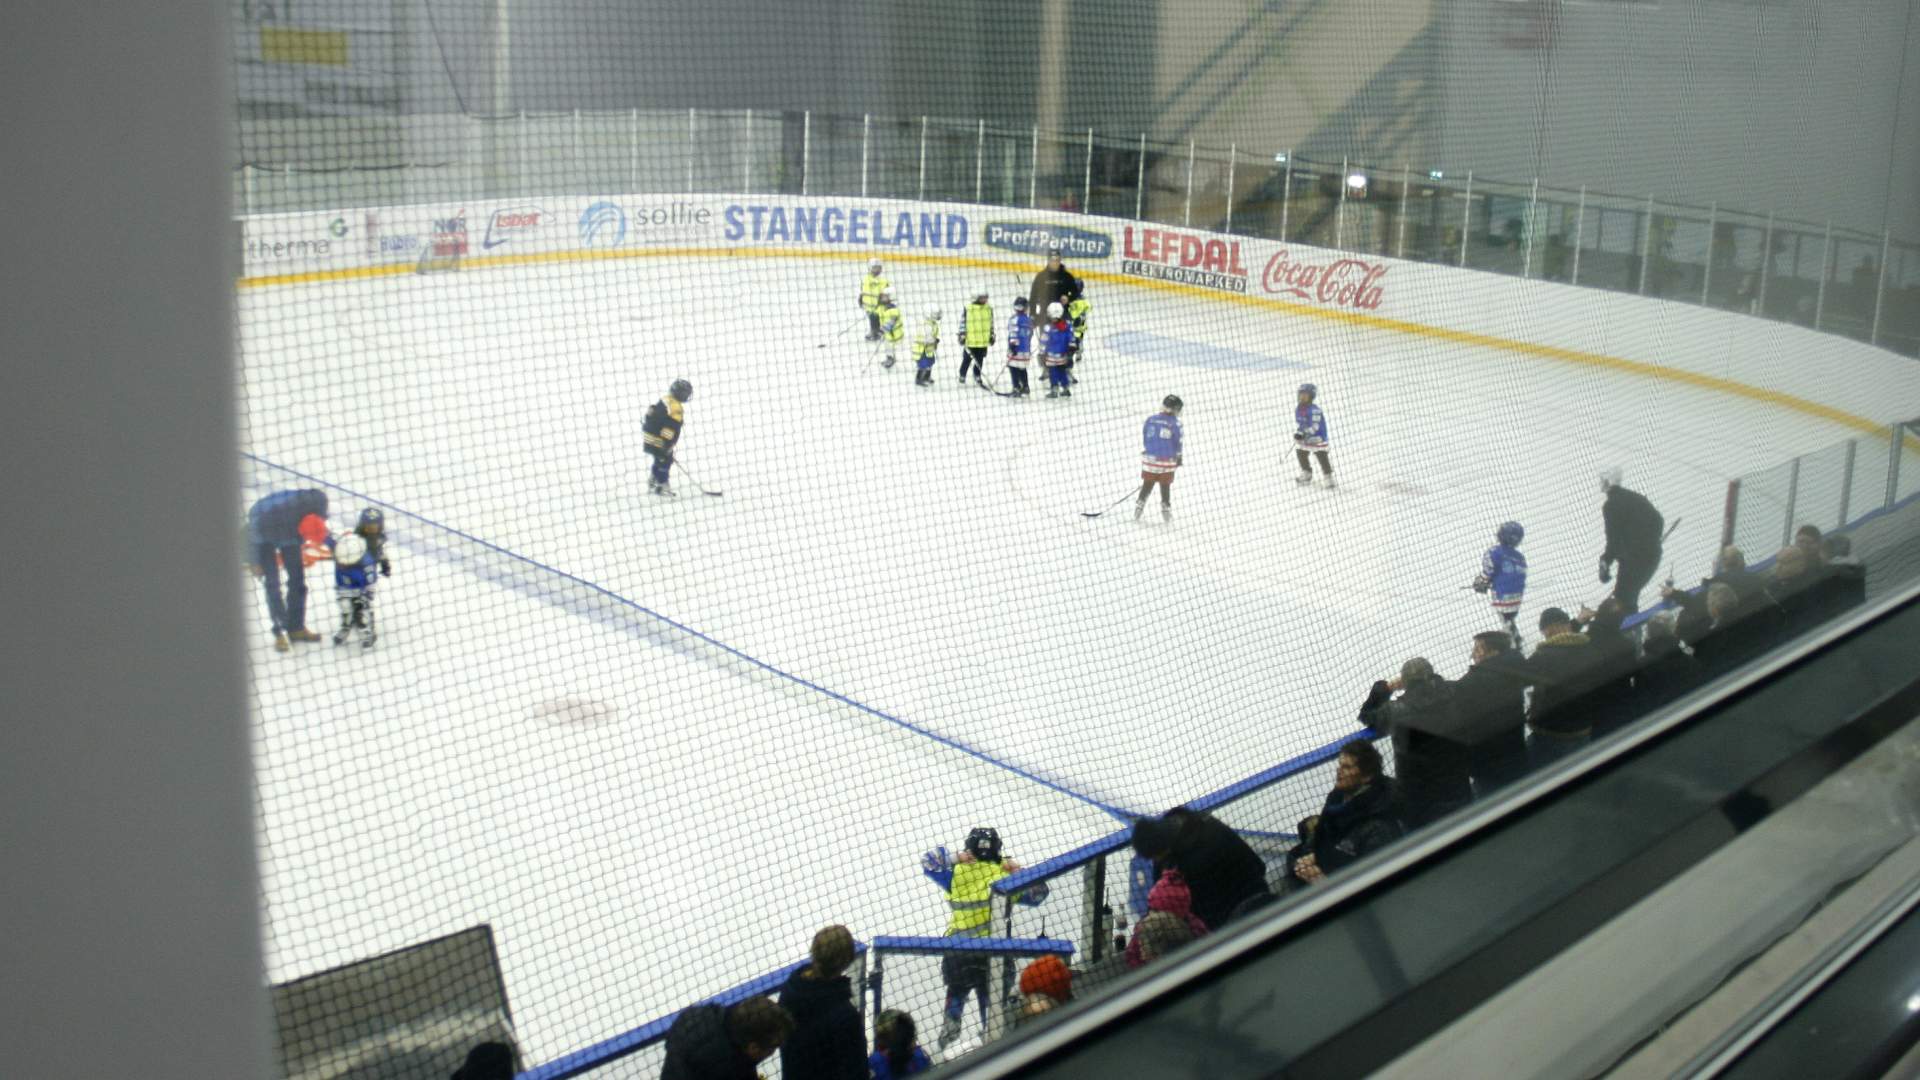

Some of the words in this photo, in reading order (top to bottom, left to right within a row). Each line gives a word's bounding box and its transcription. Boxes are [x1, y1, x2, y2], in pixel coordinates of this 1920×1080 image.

[636, 201, 711, 225] sollie
[724, 205, 968, 250] STANGELAND
[247, 238, 330, 258] therma
[991, 226, 1106, 254] ProffPartner
[1124, 226, 1248, 276] LEFDAL
[1124, 260, 1244, 291] ELEKTROMARKED
